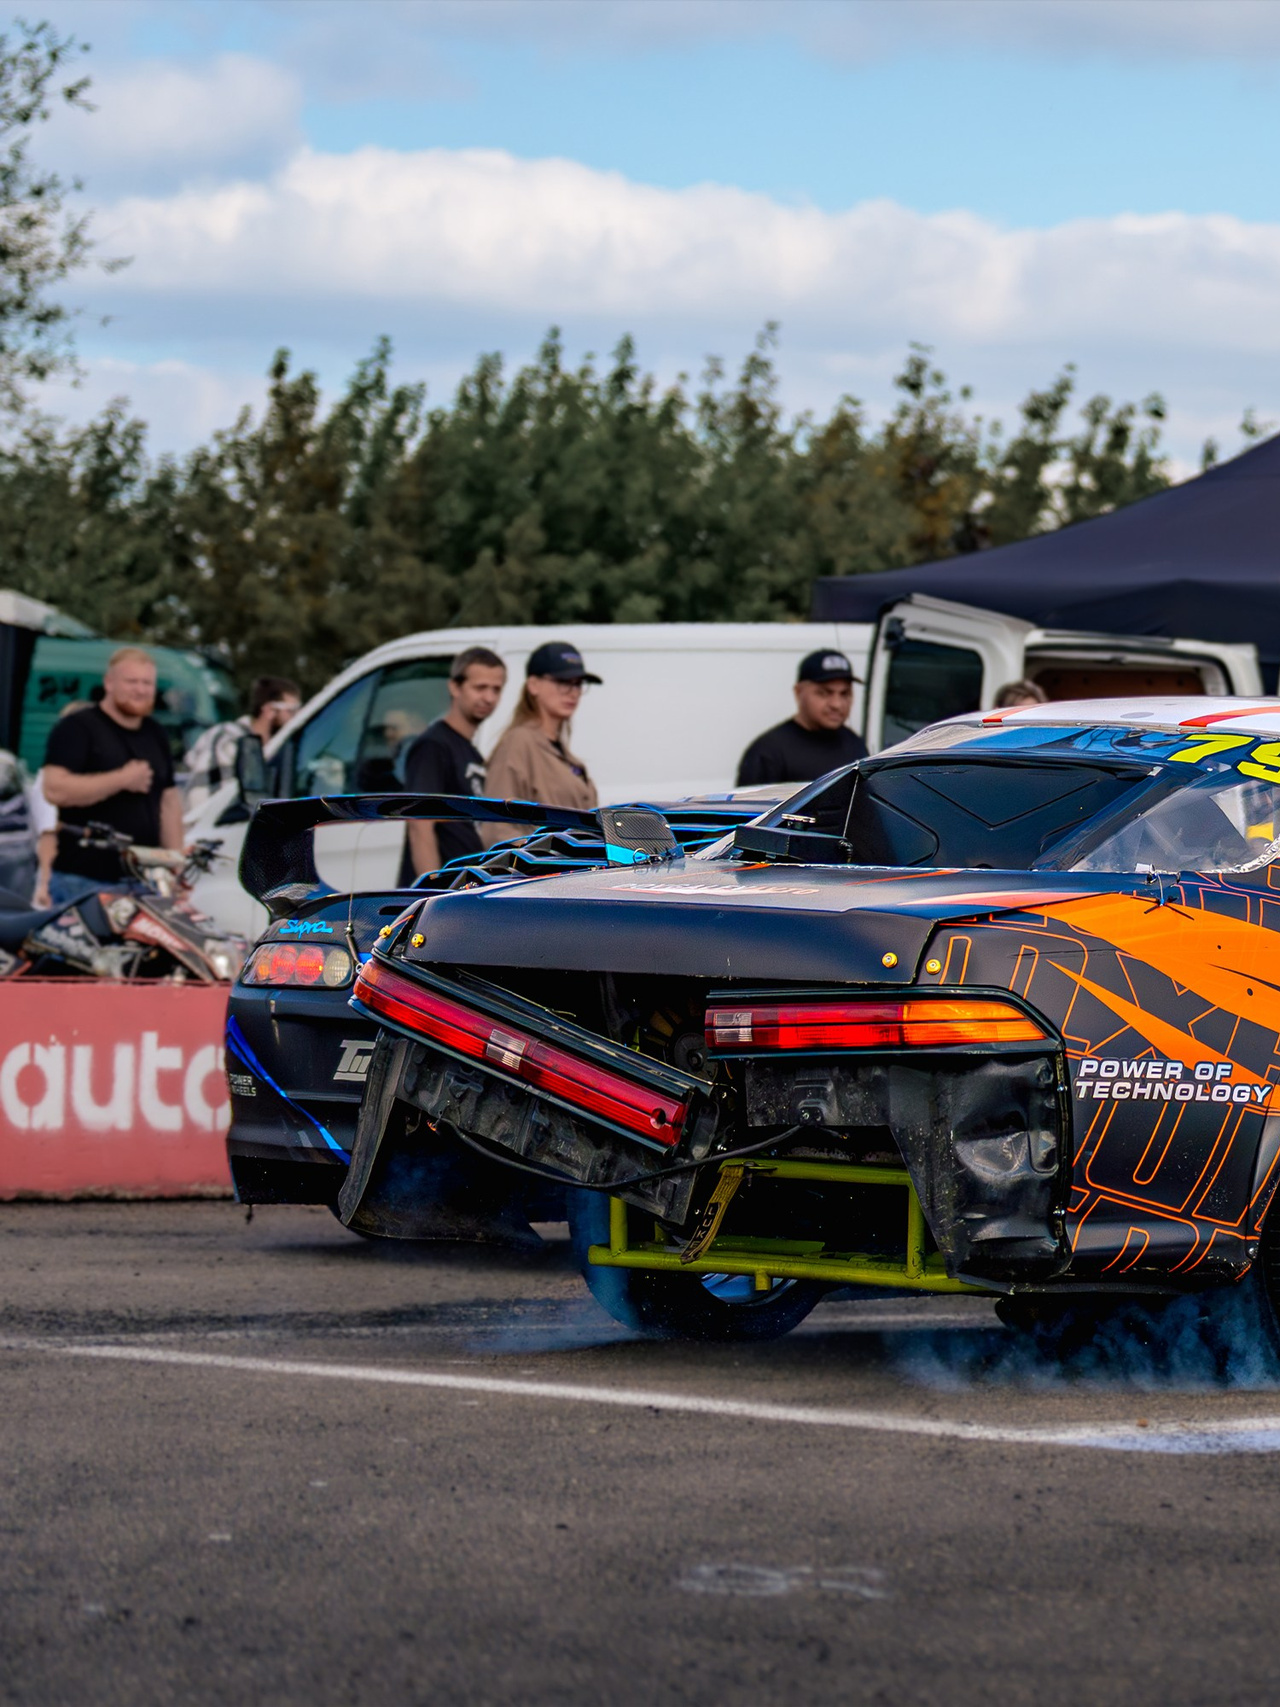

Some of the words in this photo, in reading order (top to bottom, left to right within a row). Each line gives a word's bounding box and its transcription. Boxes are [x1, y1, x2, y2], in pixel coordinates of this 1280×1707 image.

[279, 919, 334, 939] Supra
[0, 1030, 233, 1132] auto
[1078, 1059, 1185, 1080] POWER
[1193, 1061, 1233, 1081] OF
[1075, 1080, 1272, 1103] TECHNOLOGY
